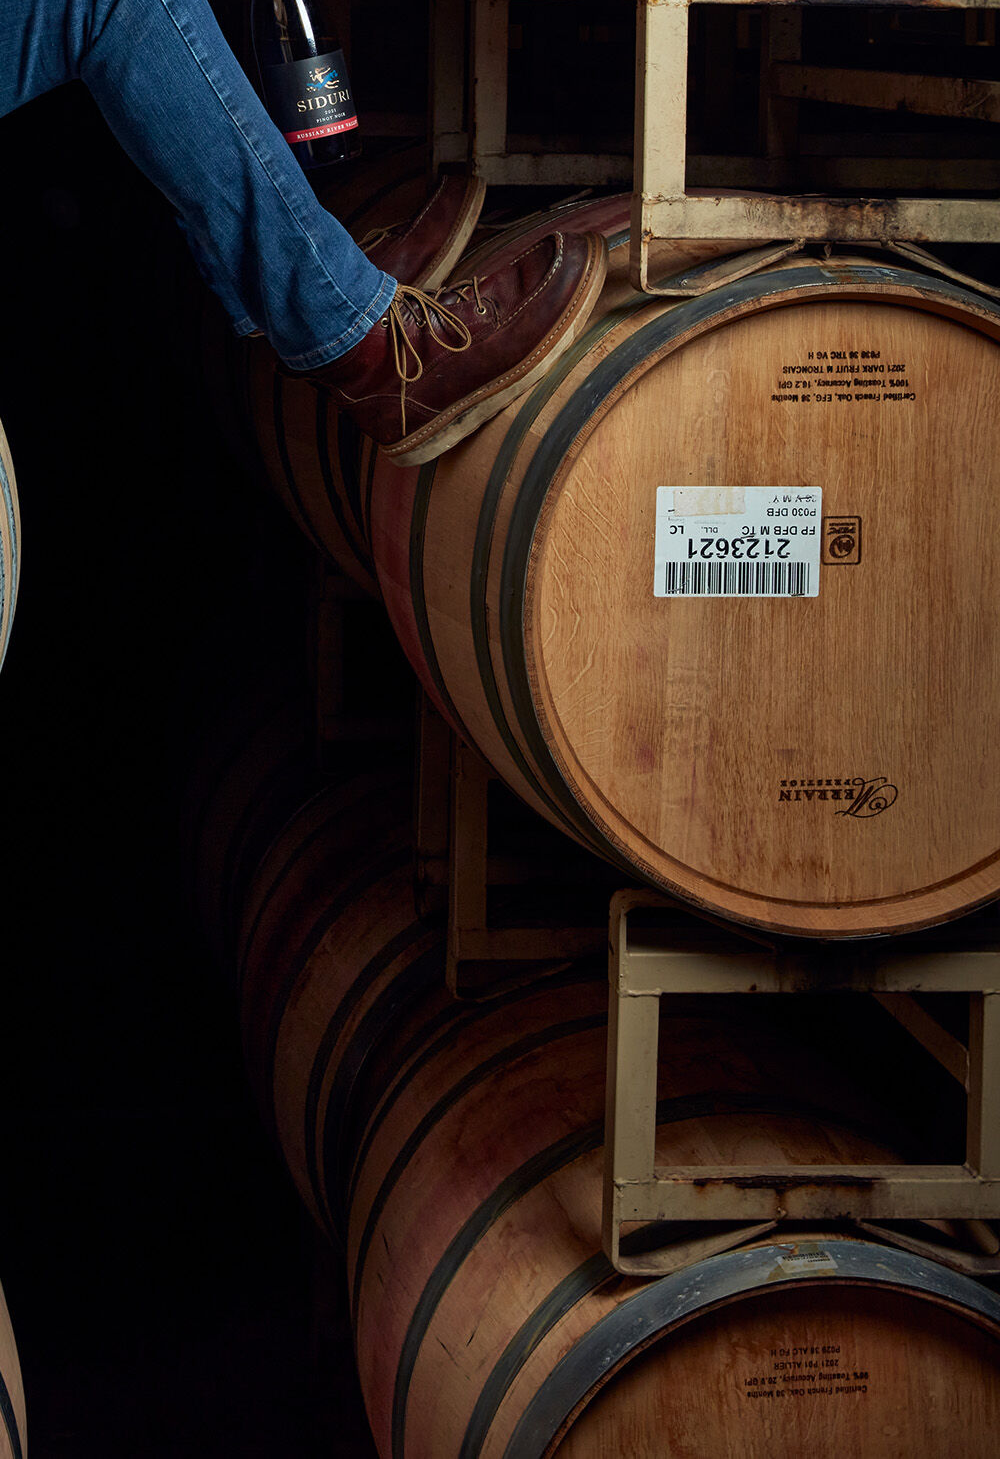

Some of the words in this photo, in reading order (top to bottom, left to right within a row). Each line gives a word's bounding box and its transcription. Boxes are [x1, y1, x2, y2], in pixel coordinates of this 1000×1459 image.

[297, 89, 350, 113] SIDURI
[316, 115, 333, 123] PINOT
[297, 130, 325, 139] RUSSIAN
[327, 125, 344, 133] RIVER
[771, 394, 798, 402] Months
[855, 393, 880, 401] French
[782, 495, 791, 503] M
[767, 508, 789, 516] DFB
[792, 508, 816, 516] P030
[669, 525, 684, 534] LC
[741, 526, 756, 535] TC
[760, 526, 770, 535] M
[773, 526, 797, 535] DFB
[801, 525, 815, 535] FP
[687, 538, 790, 559] 2123621
[780, 779, 851, 787] PRESTIGE
[778, 777, 898, 818] MERRAIN
[774, 1362, 801, 1370] ALLIER
[747, 1391, 773, 1399] Months
[808, 1387, 832, 1395] French
